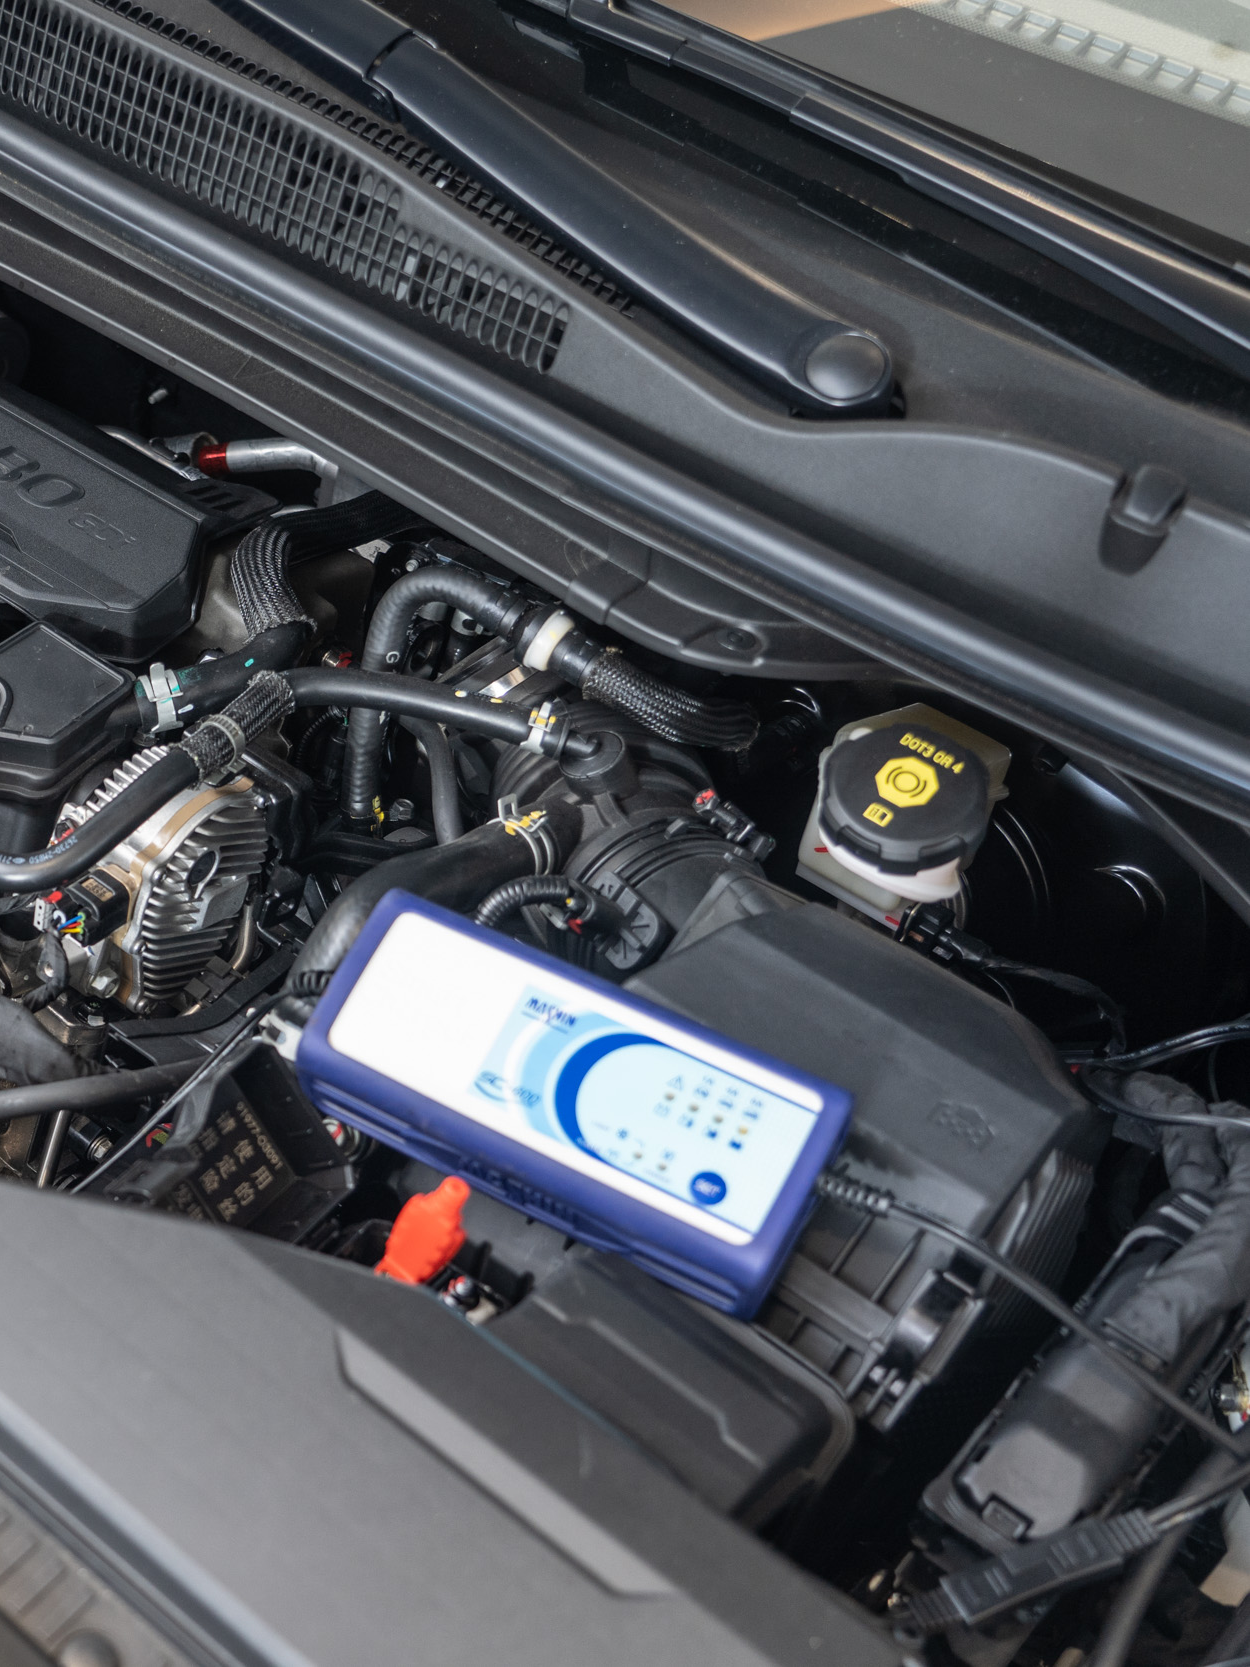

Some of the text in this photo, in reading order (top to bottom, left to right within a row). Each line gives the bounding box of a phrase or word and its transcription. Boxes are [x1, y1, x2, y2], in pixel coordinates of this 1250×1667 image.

[899, 732, 965, 774] DOT3 OR 4
